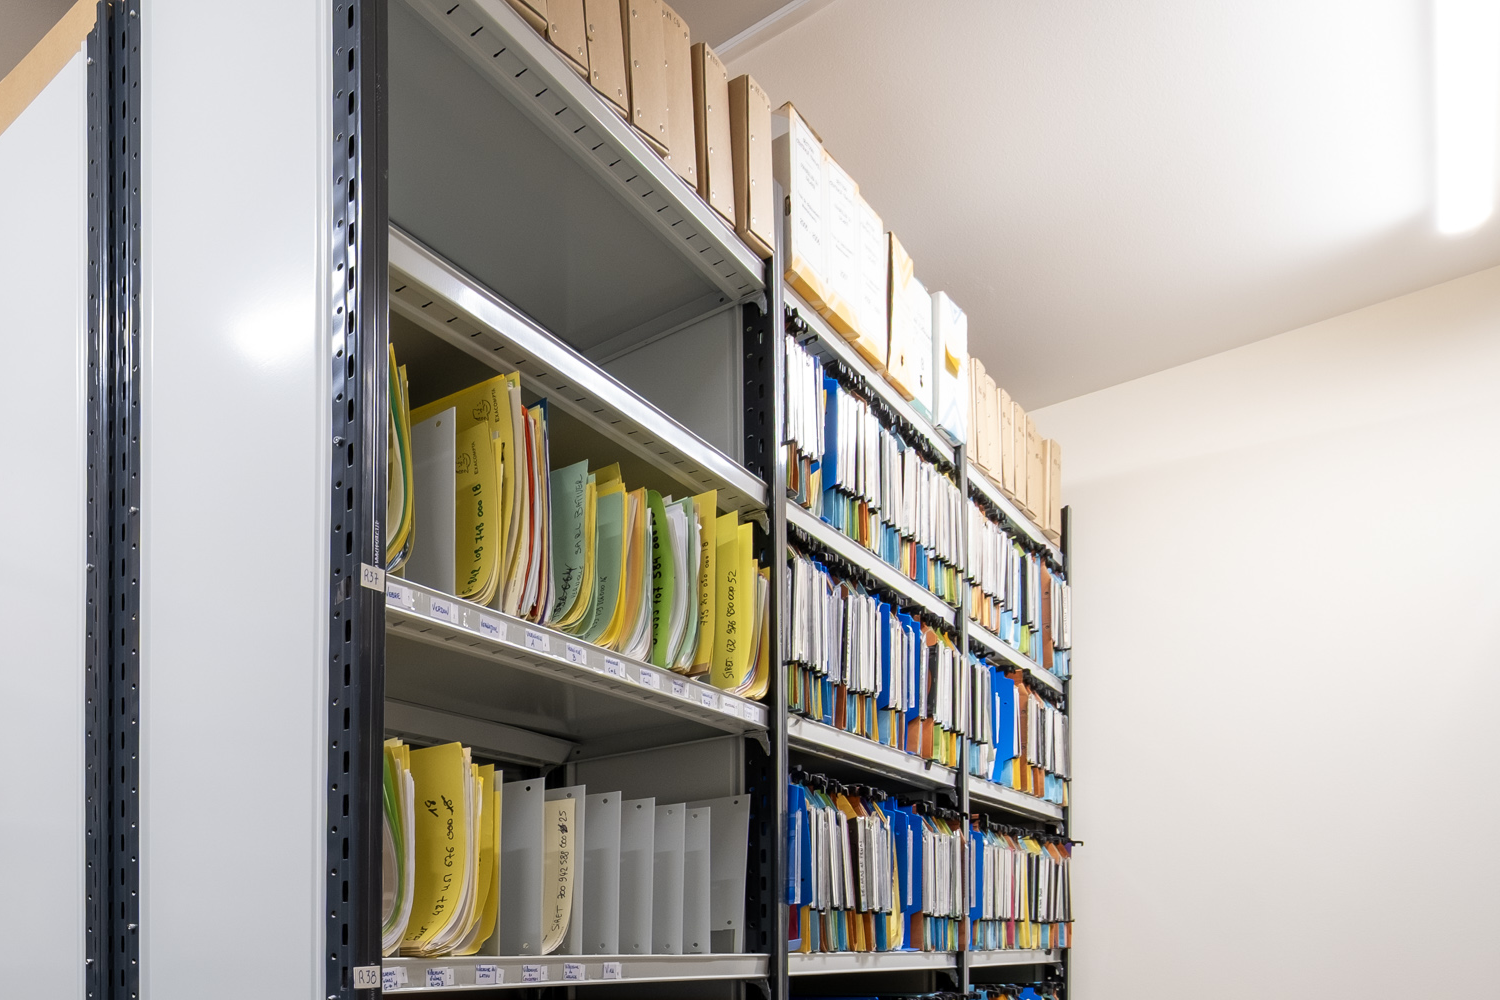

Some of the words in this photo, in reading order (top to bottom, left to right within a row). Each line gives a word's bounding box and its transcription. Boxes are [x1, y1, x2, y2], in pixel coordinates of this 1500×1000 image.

[492, 387, 500, 423] EXACOMPTA
[471, 483, 482, 498] 18
[475, 522, 485, 542] 748
[362, 569, 380, 584] R37
[727, 569, 738, 585] 52
[558, 810, 568, 823] 25
[558, 866, 568, 883] 942
[358, 969, 377, 985] R38
